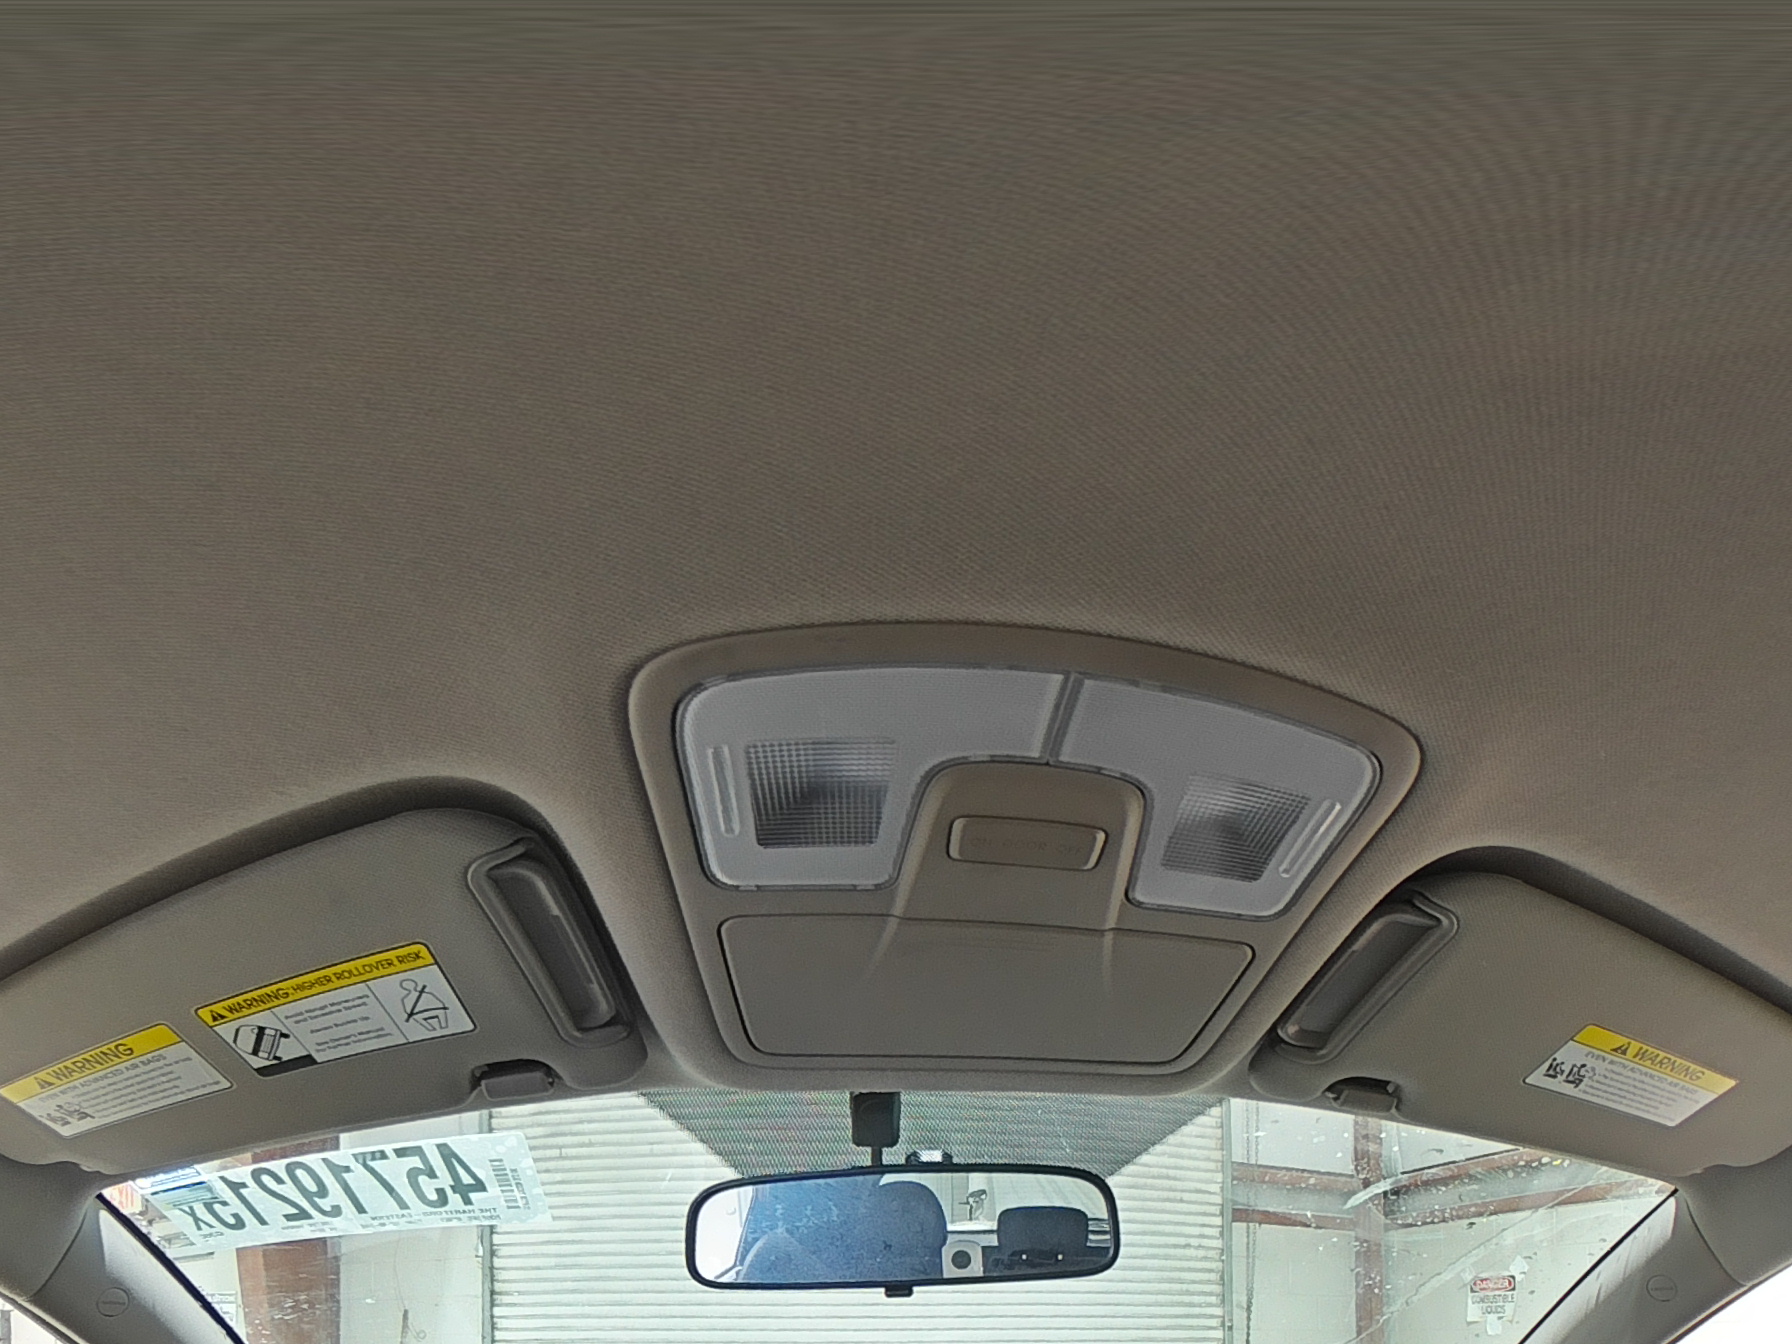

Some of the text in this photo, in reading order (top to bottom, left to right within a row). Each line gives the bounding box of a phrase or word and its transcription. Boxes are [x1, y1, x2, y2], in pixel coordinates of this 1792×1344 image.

[293, 974, 334, 997] HIGHER
[334, 957, 395, 983] ROLLOVER
[396, 949, 426, 966] RISK
[46, 1042, 135, 1082] WARNING
[1633, 1045, 1706, 1082] WARNING
